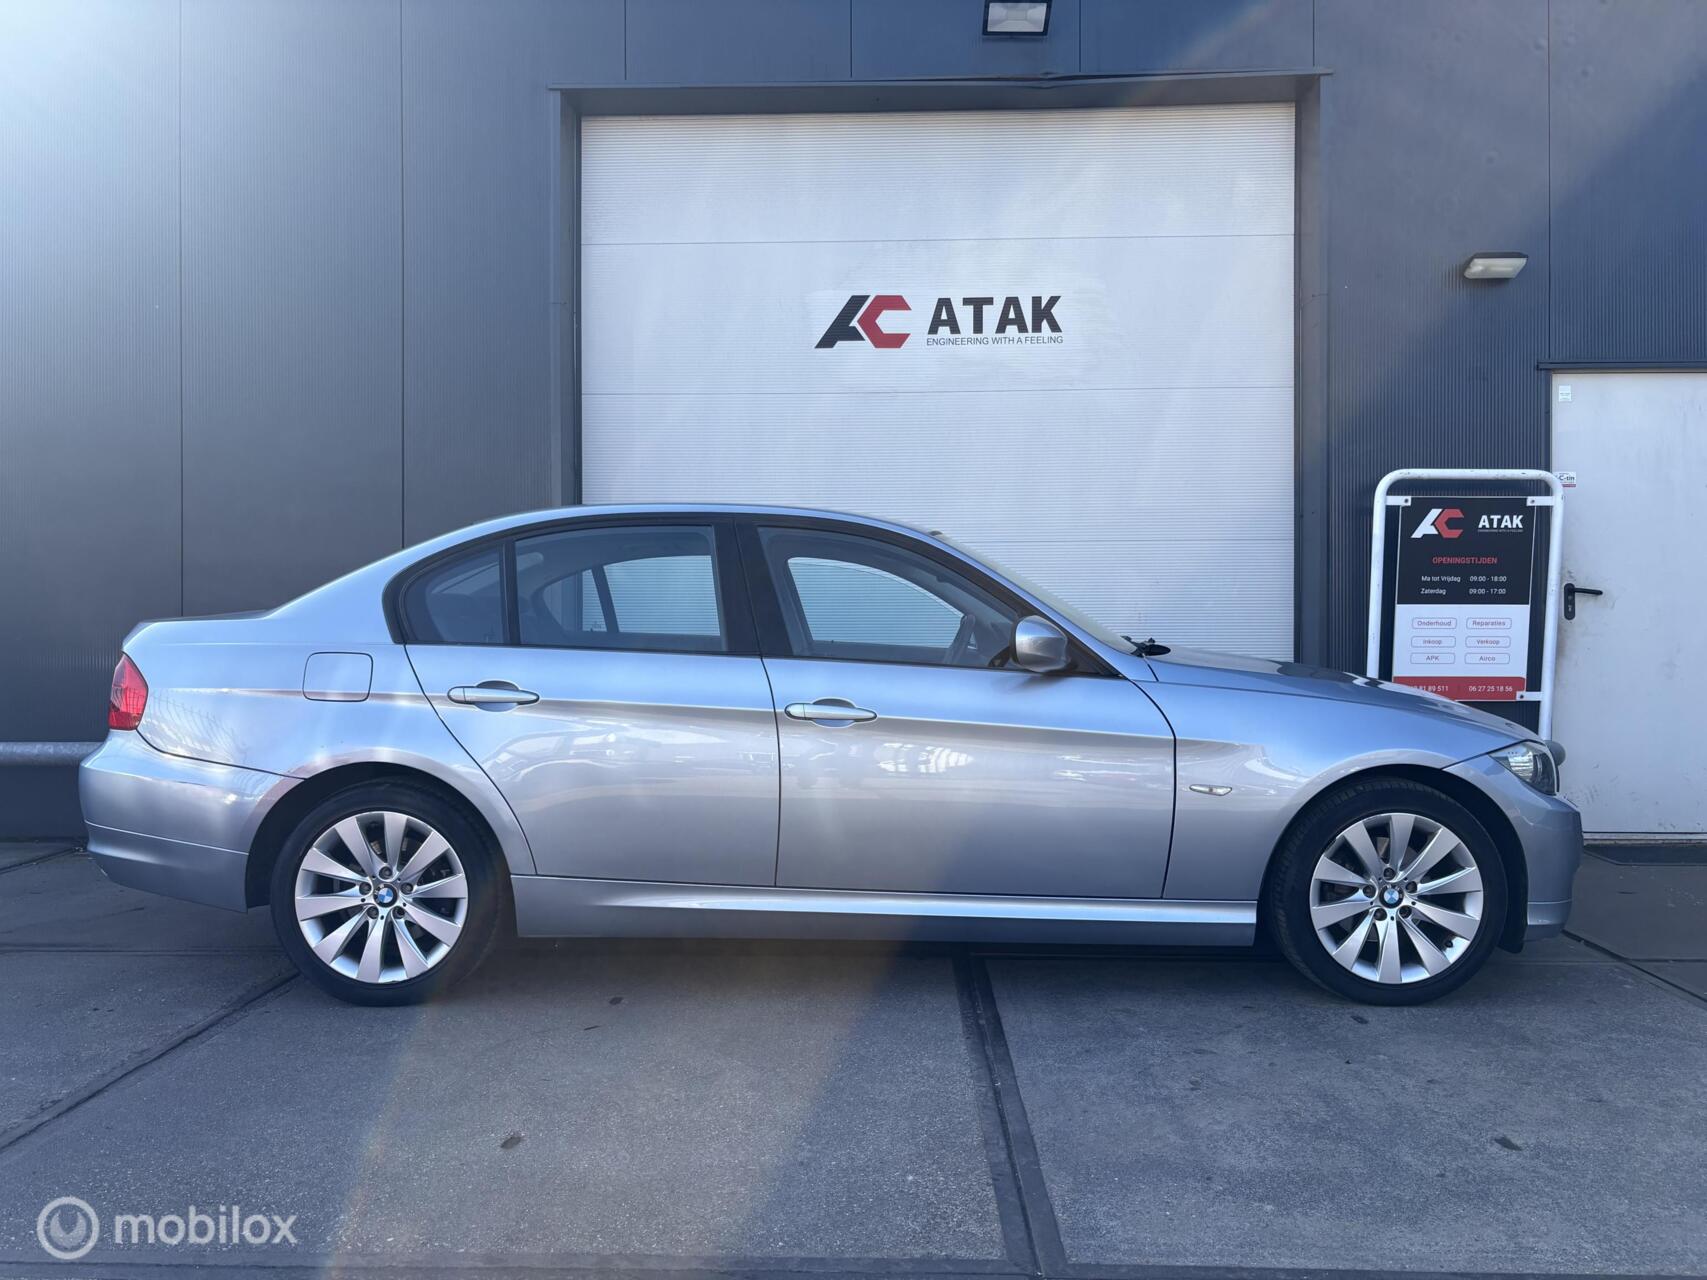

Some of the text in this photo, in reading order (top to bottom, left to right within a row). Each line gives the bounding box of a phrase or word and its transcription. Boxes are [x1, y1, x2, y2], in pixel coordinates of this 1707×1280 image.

[927, 295, 1063, 335] ATAK
[926, 336, 1063, 346] ENGINEERING WITH A FEELING
[1478, 514, 1524, 528] ATAK
[1441, 575, 1461, 583] Vrijdag
[1472, 620, 1506, 628] Reparaties
[1423, 638, 1442, 646] Inkoop
[1476, 638, 1500, 646] Verkoop
